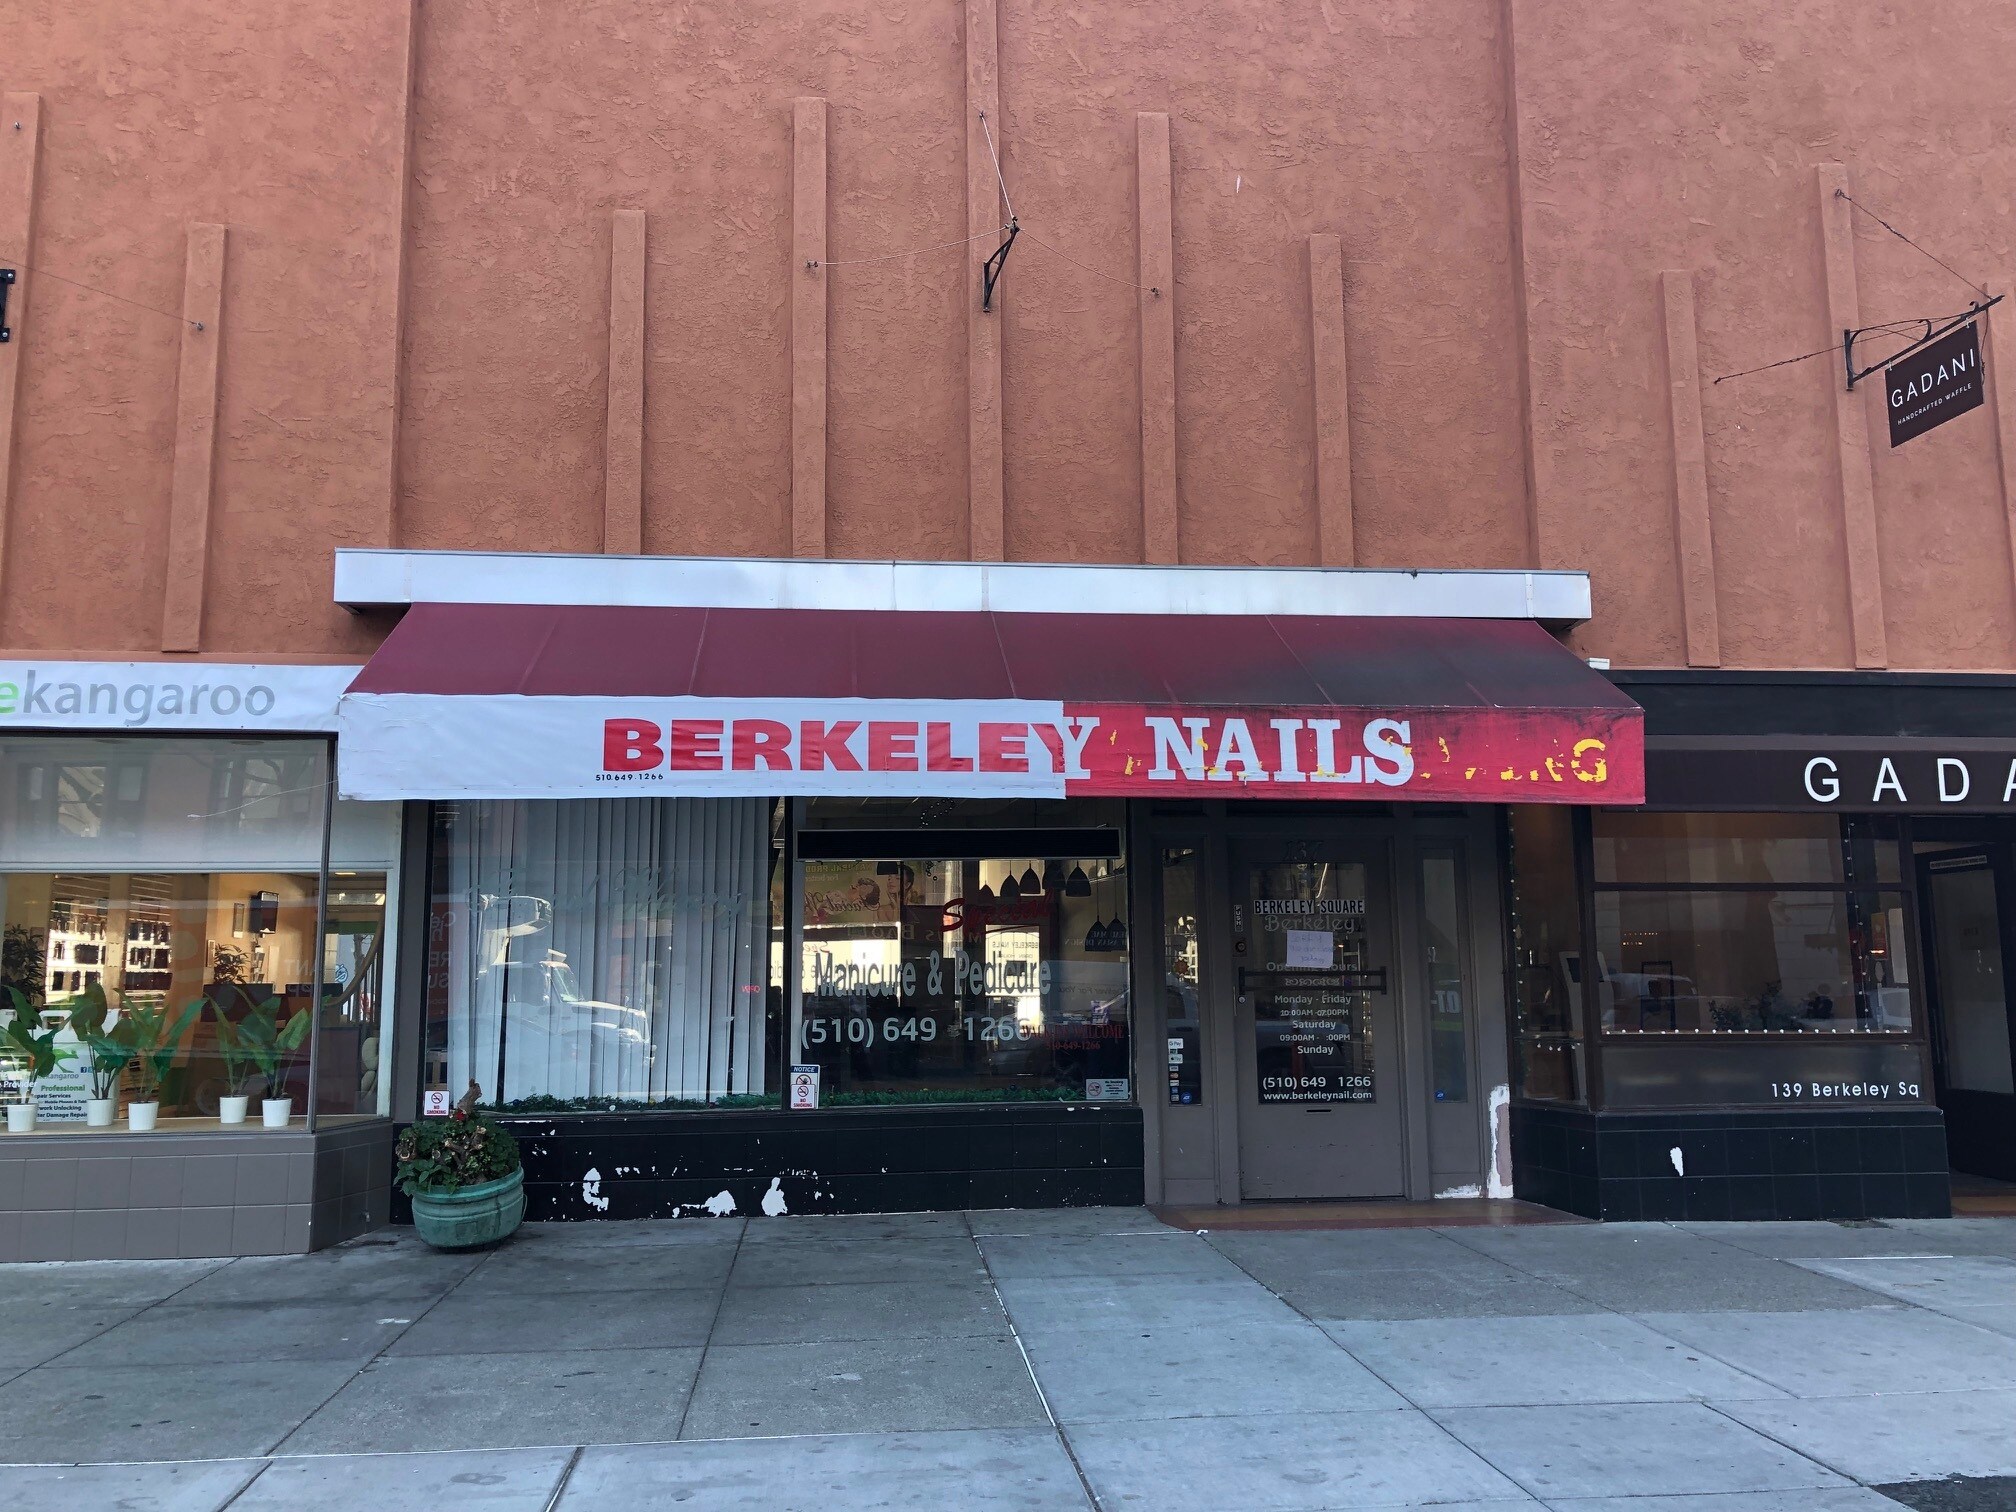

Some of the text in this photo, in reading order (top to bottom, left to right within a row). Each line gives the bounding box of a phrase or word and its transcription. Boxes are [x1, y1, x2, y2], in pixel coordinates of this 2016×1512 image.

[1891, 348, 1975, 408] GADANI
[1897, 382, 1973, 426] HANDCRAFTED WAFFLE
[602, 716, 1100, 779] BERKELEY
[1145, 716, 1415, 787] NAILS
[1255, 900, 1364, 914] BERKELEY SQUARE
[1264, 914, 1355, 934] Berkeley
[814, 950, 1051, 997] Manicure & Pedicure
[1274, 995, 1313, 1004] Monday
[1321, 995, 1352, 1004] Friday
[801, 1017, 1031, 1048] (510) 649 1266
[1292, 1020, 1336, 1029] Saturday
[1297, 1045, 1334, 1055] Sunday
[1262, 1076, 1371, 1090] (510) 649 1266
[1771, 1081, 1919, 1099] 139 Berkeley Sq
[1263, 1091, 1372, 1101] www.berkeleynail.com
